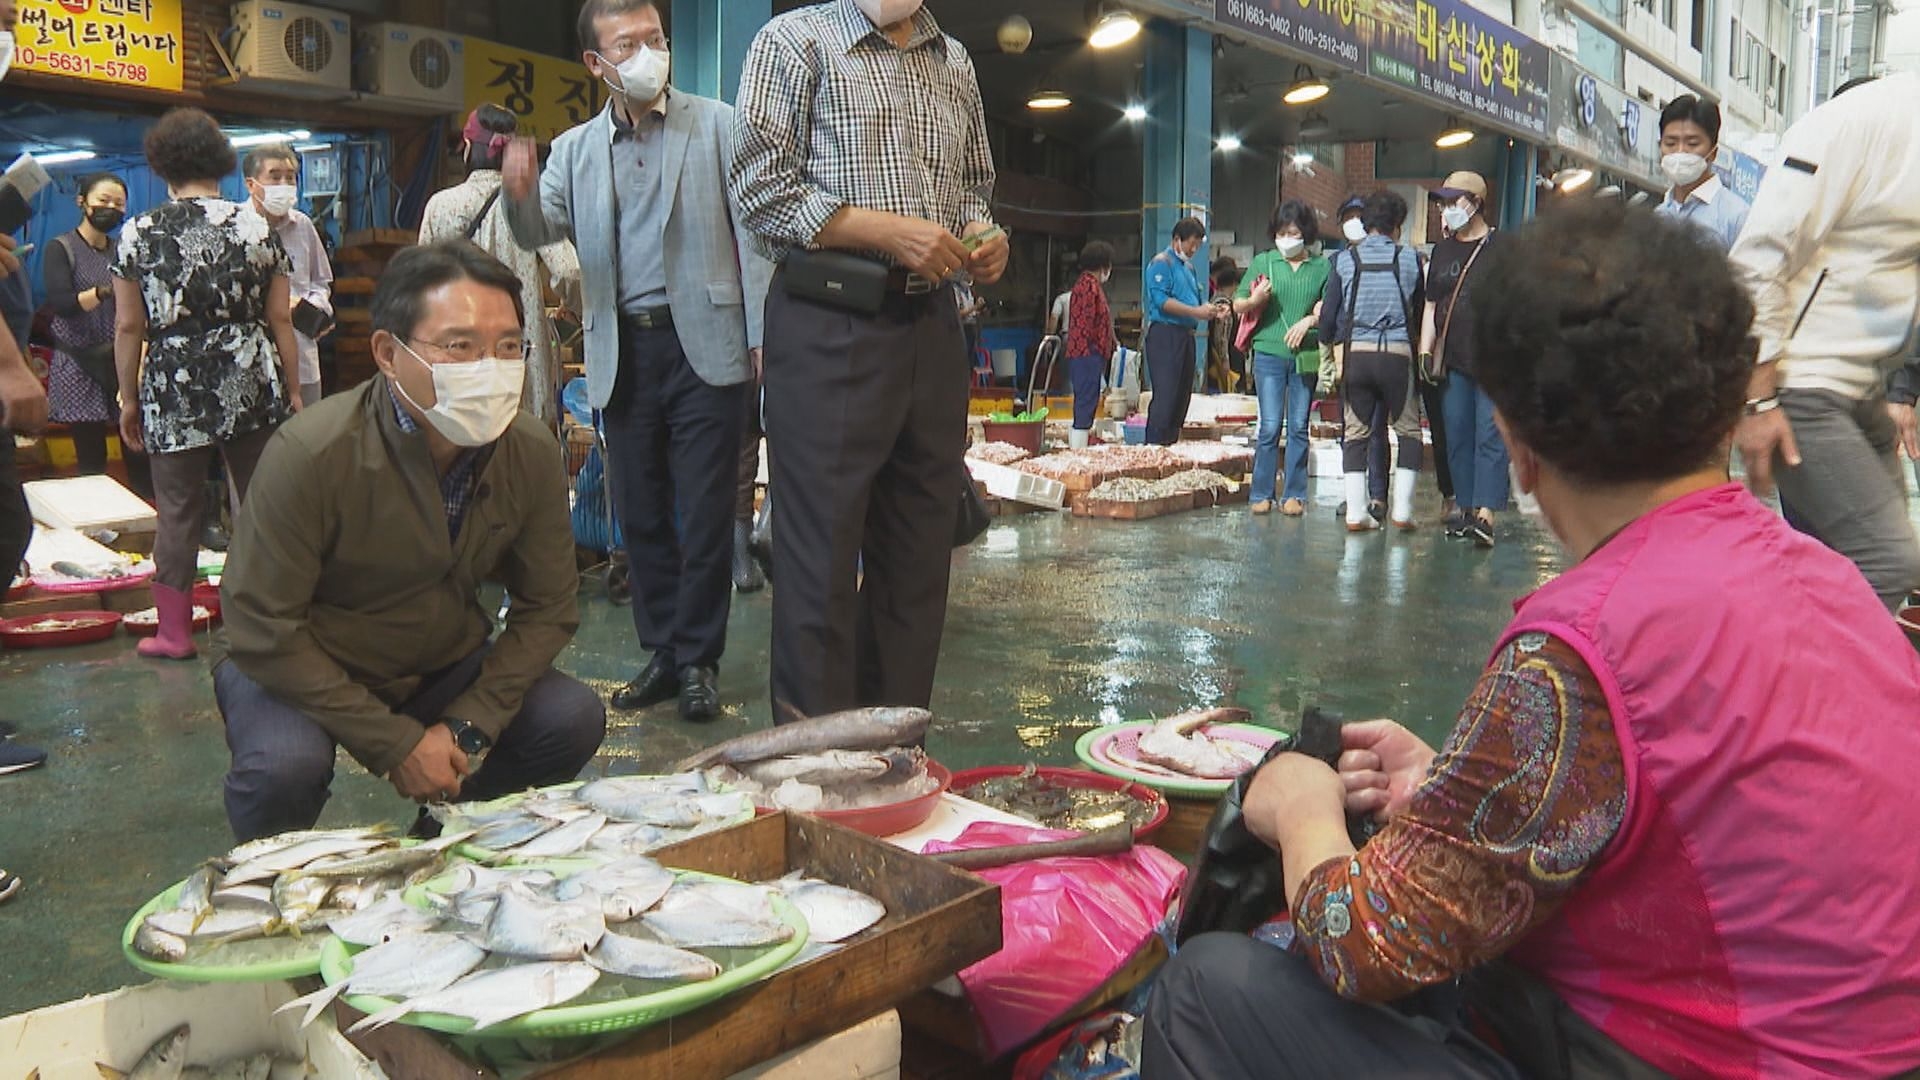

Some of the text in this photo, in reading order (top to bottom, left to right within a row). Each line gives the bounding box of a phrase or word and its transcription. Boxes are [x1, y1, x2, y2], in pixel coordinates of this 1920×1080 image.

[1416, 0, 1519, 97] 대신상회
[1420, 71, 1432, 91] TEL
[1504, 104, 1514, 122] FAX
